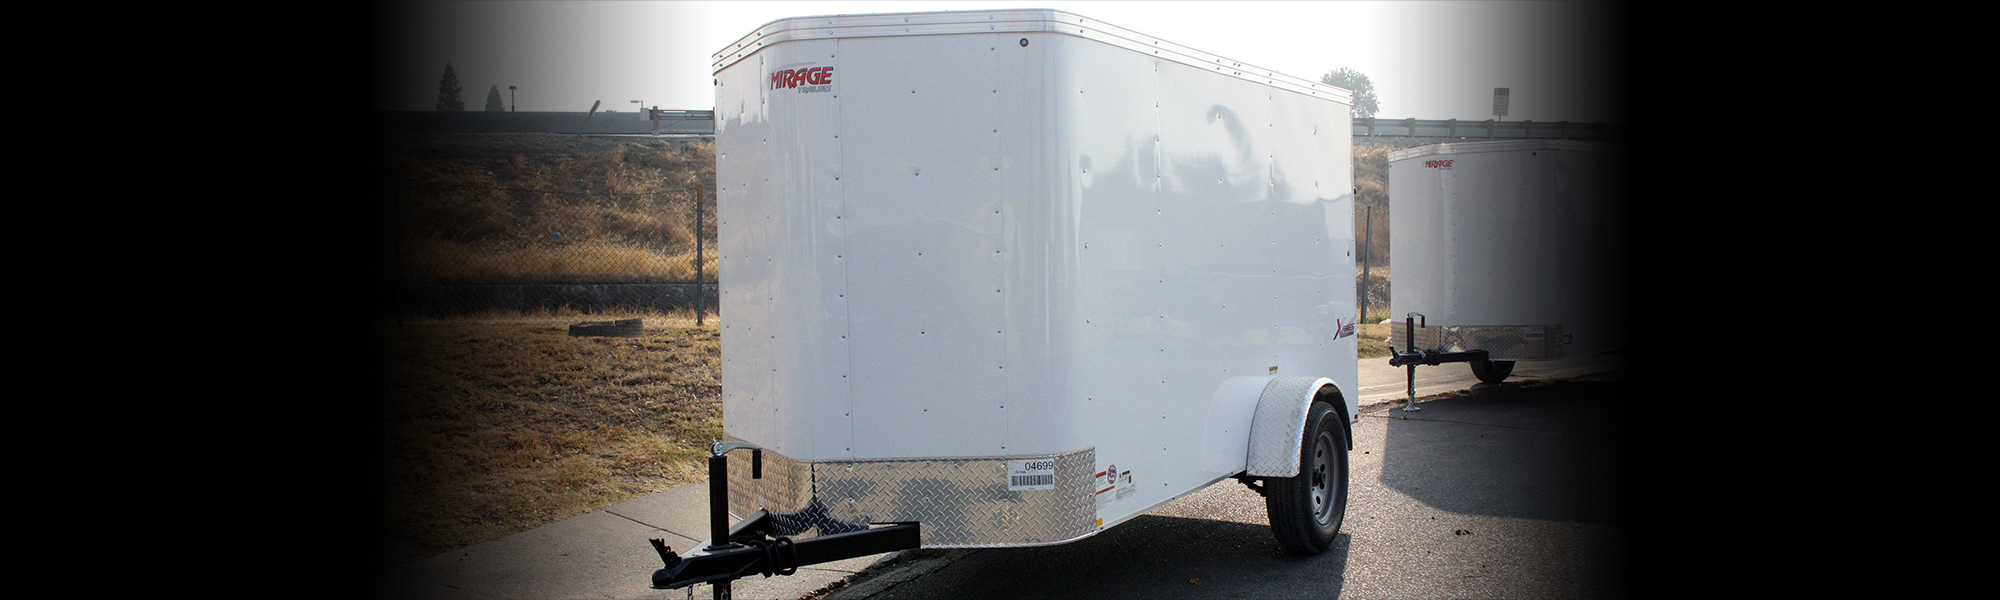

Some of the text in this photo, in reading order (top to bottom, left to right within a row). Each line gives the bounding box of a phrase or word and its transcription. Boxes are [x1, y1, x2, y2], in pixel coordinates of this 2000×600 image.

[770, 66, 834, 90] MIRAGE
[1425, 160, 1453, 169] MIRAGE
[1025, 461, 1054, 471] 04699
